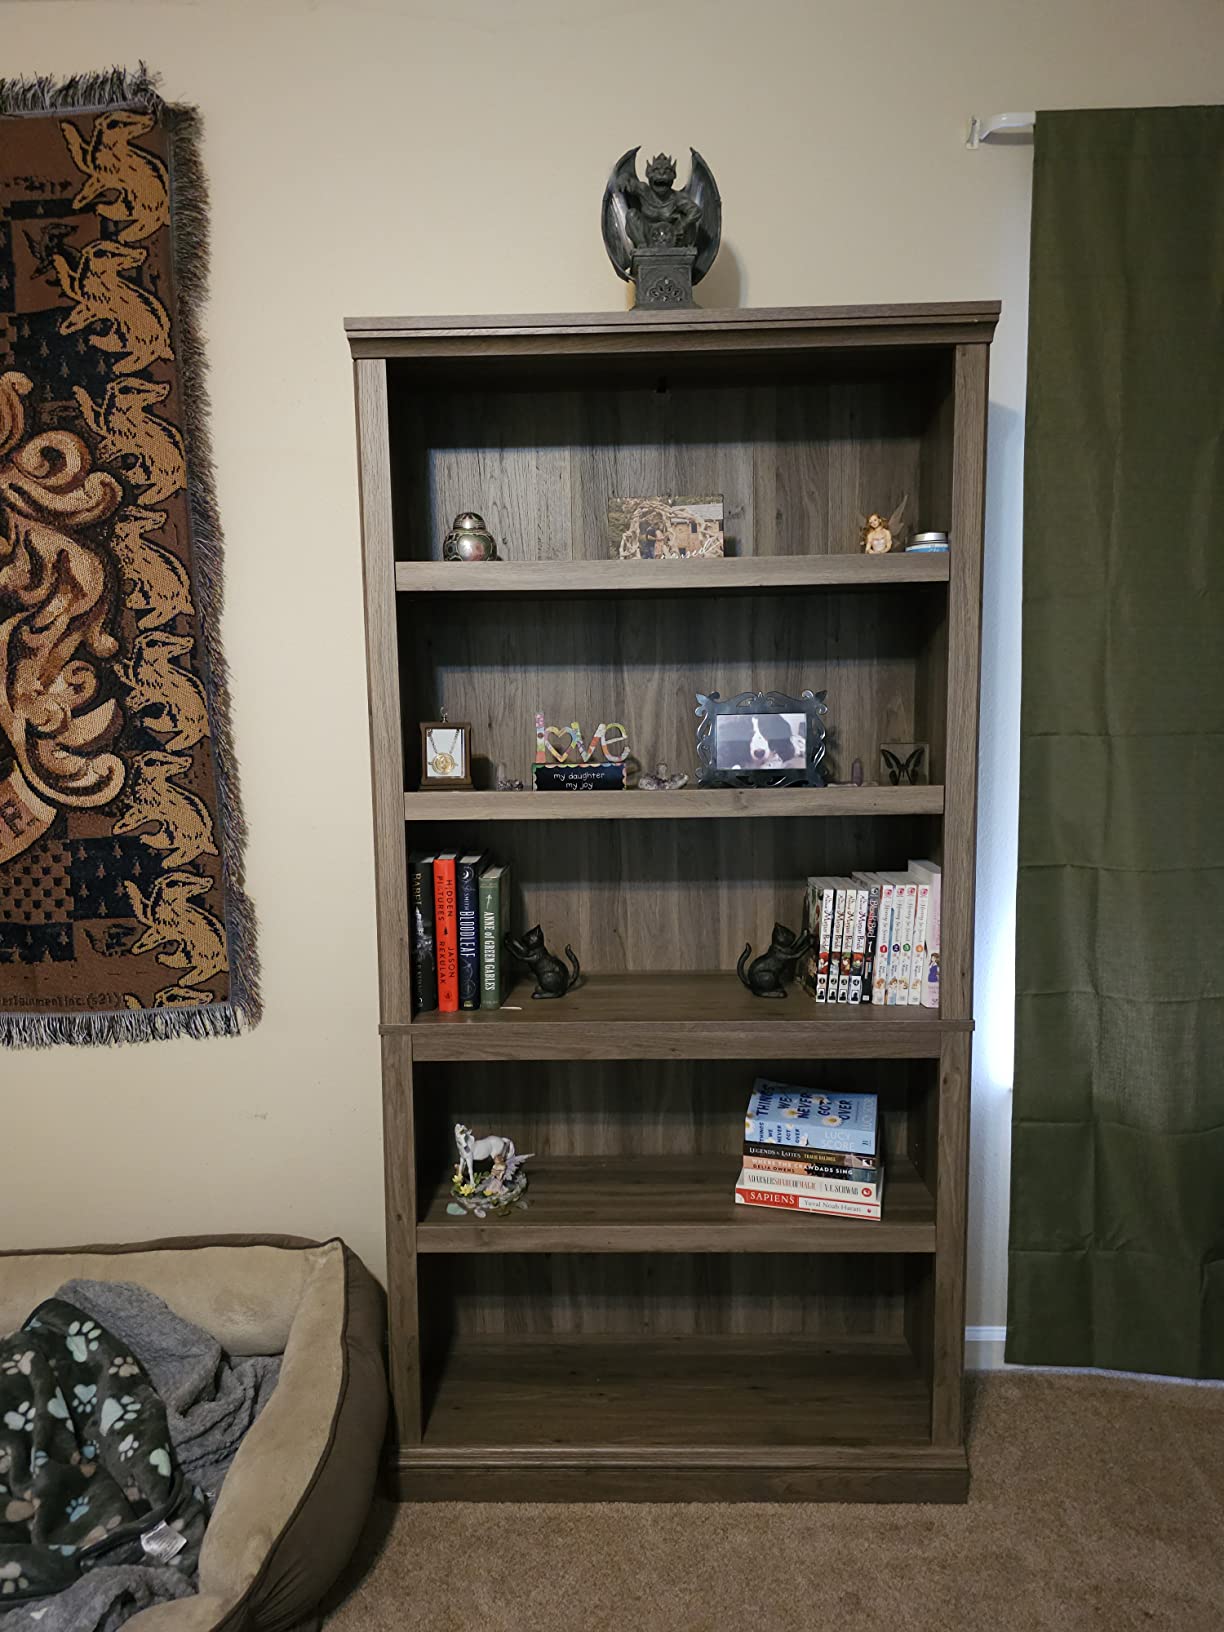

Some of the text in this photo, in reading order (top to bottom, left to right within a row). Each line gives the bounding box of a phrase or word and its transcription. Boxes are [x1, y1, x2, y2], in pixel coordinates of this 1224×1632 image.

[553, 772, 605, 781] my daughter
[566, 782, 593, 790] my joy
[436, 876, 445, 921] PICTURES
[446, 879, 454, 917] HIDDEN
[484, 912, 495, 931] ANNE
[459, 911, 476, 958] BLOODLEAF
[485, 932, 495, 941] of
[447, 947, 455, 978] JASON
[484, 941, 495, 963] GREEN
[484, 964, 496, 991] GABLES
[756, 1084, 775, 1116] THINGS
[797, 1093, 812, 1119] NEVER
[838, 1099, 852, 1120] OVER
[749, 1147, 776, 1155] LEGENDS
[781, 1150, 801, 1158] LATTES
[751, 1158, 773, 1166] WHERE
[794, 1163, 834, 1173] CRAWDADS
[750, 1191, 861, 1212] SAPIENS Yuval Noah Harari
